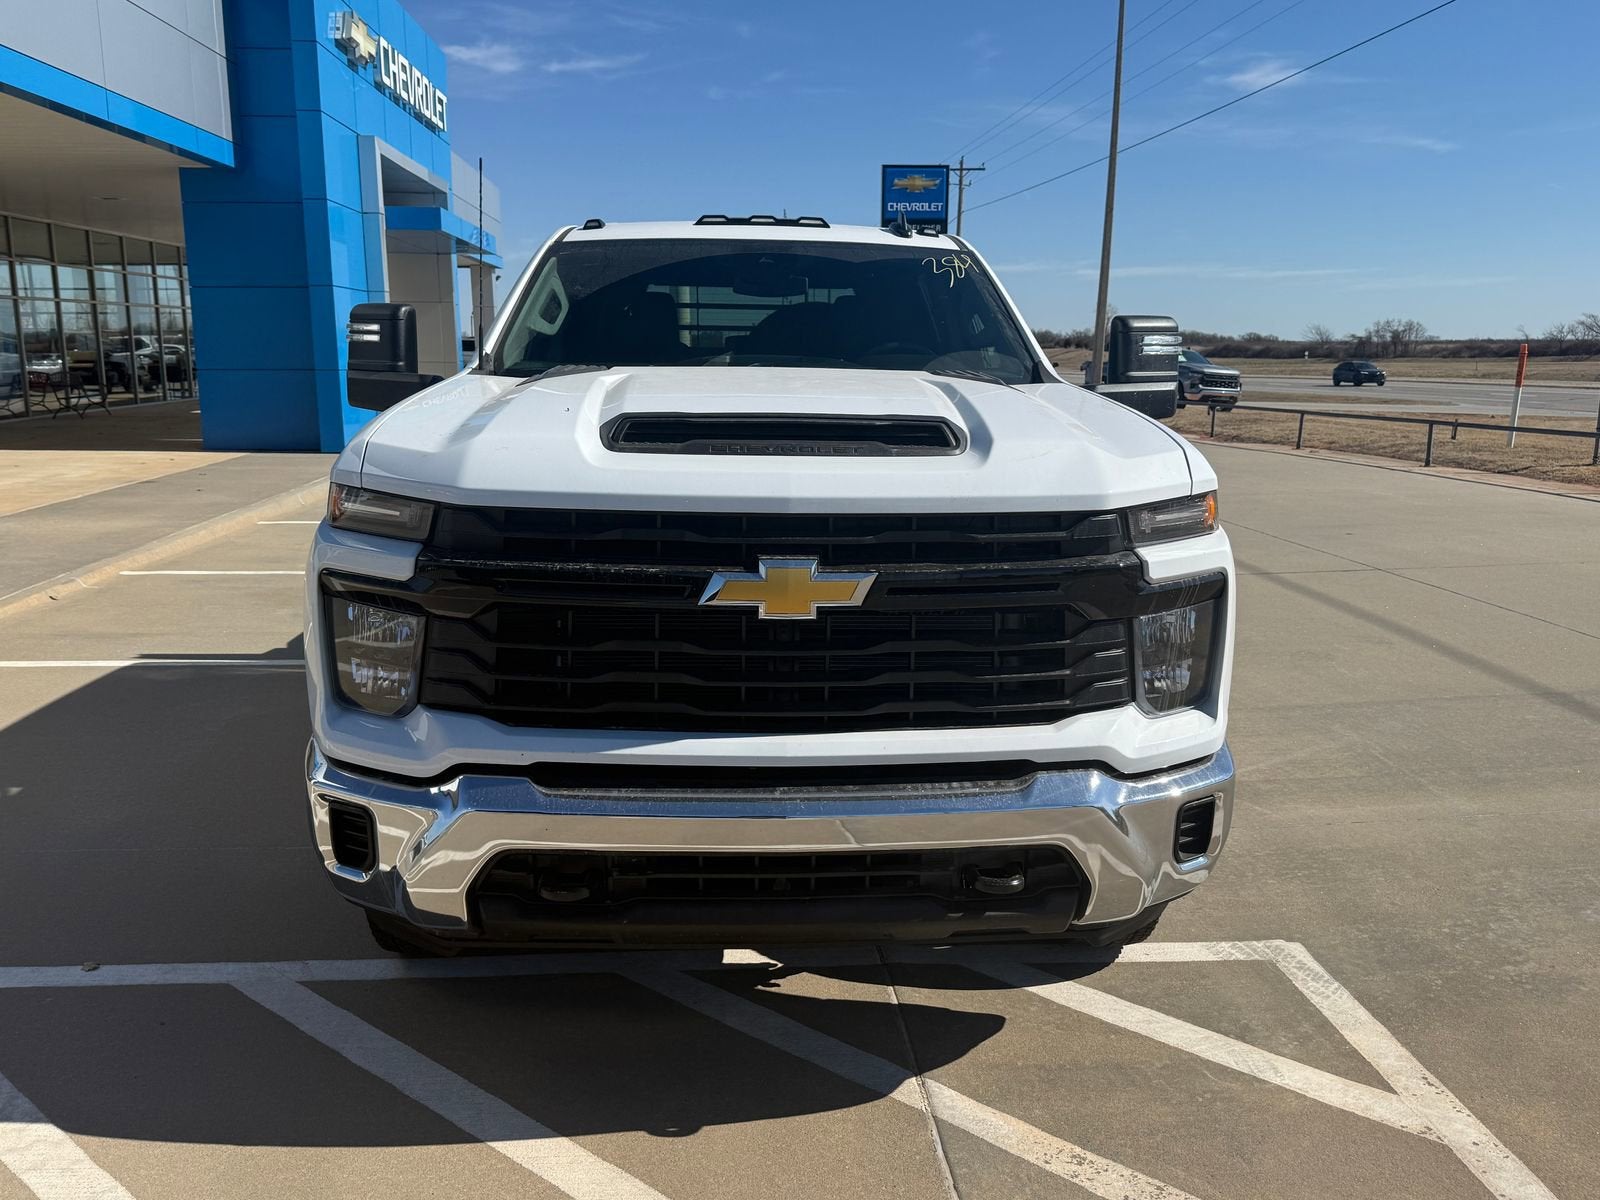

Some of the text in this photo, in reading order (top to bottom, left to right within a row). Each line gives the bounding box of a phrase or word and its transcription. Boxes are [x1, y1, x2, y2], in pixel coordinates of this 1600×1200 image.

[379, 36, 448, 132] CHEVROLET
[887, 202, 944, 212] CHEVROLET
[709, 444, 865, 454] CHEVROLET
